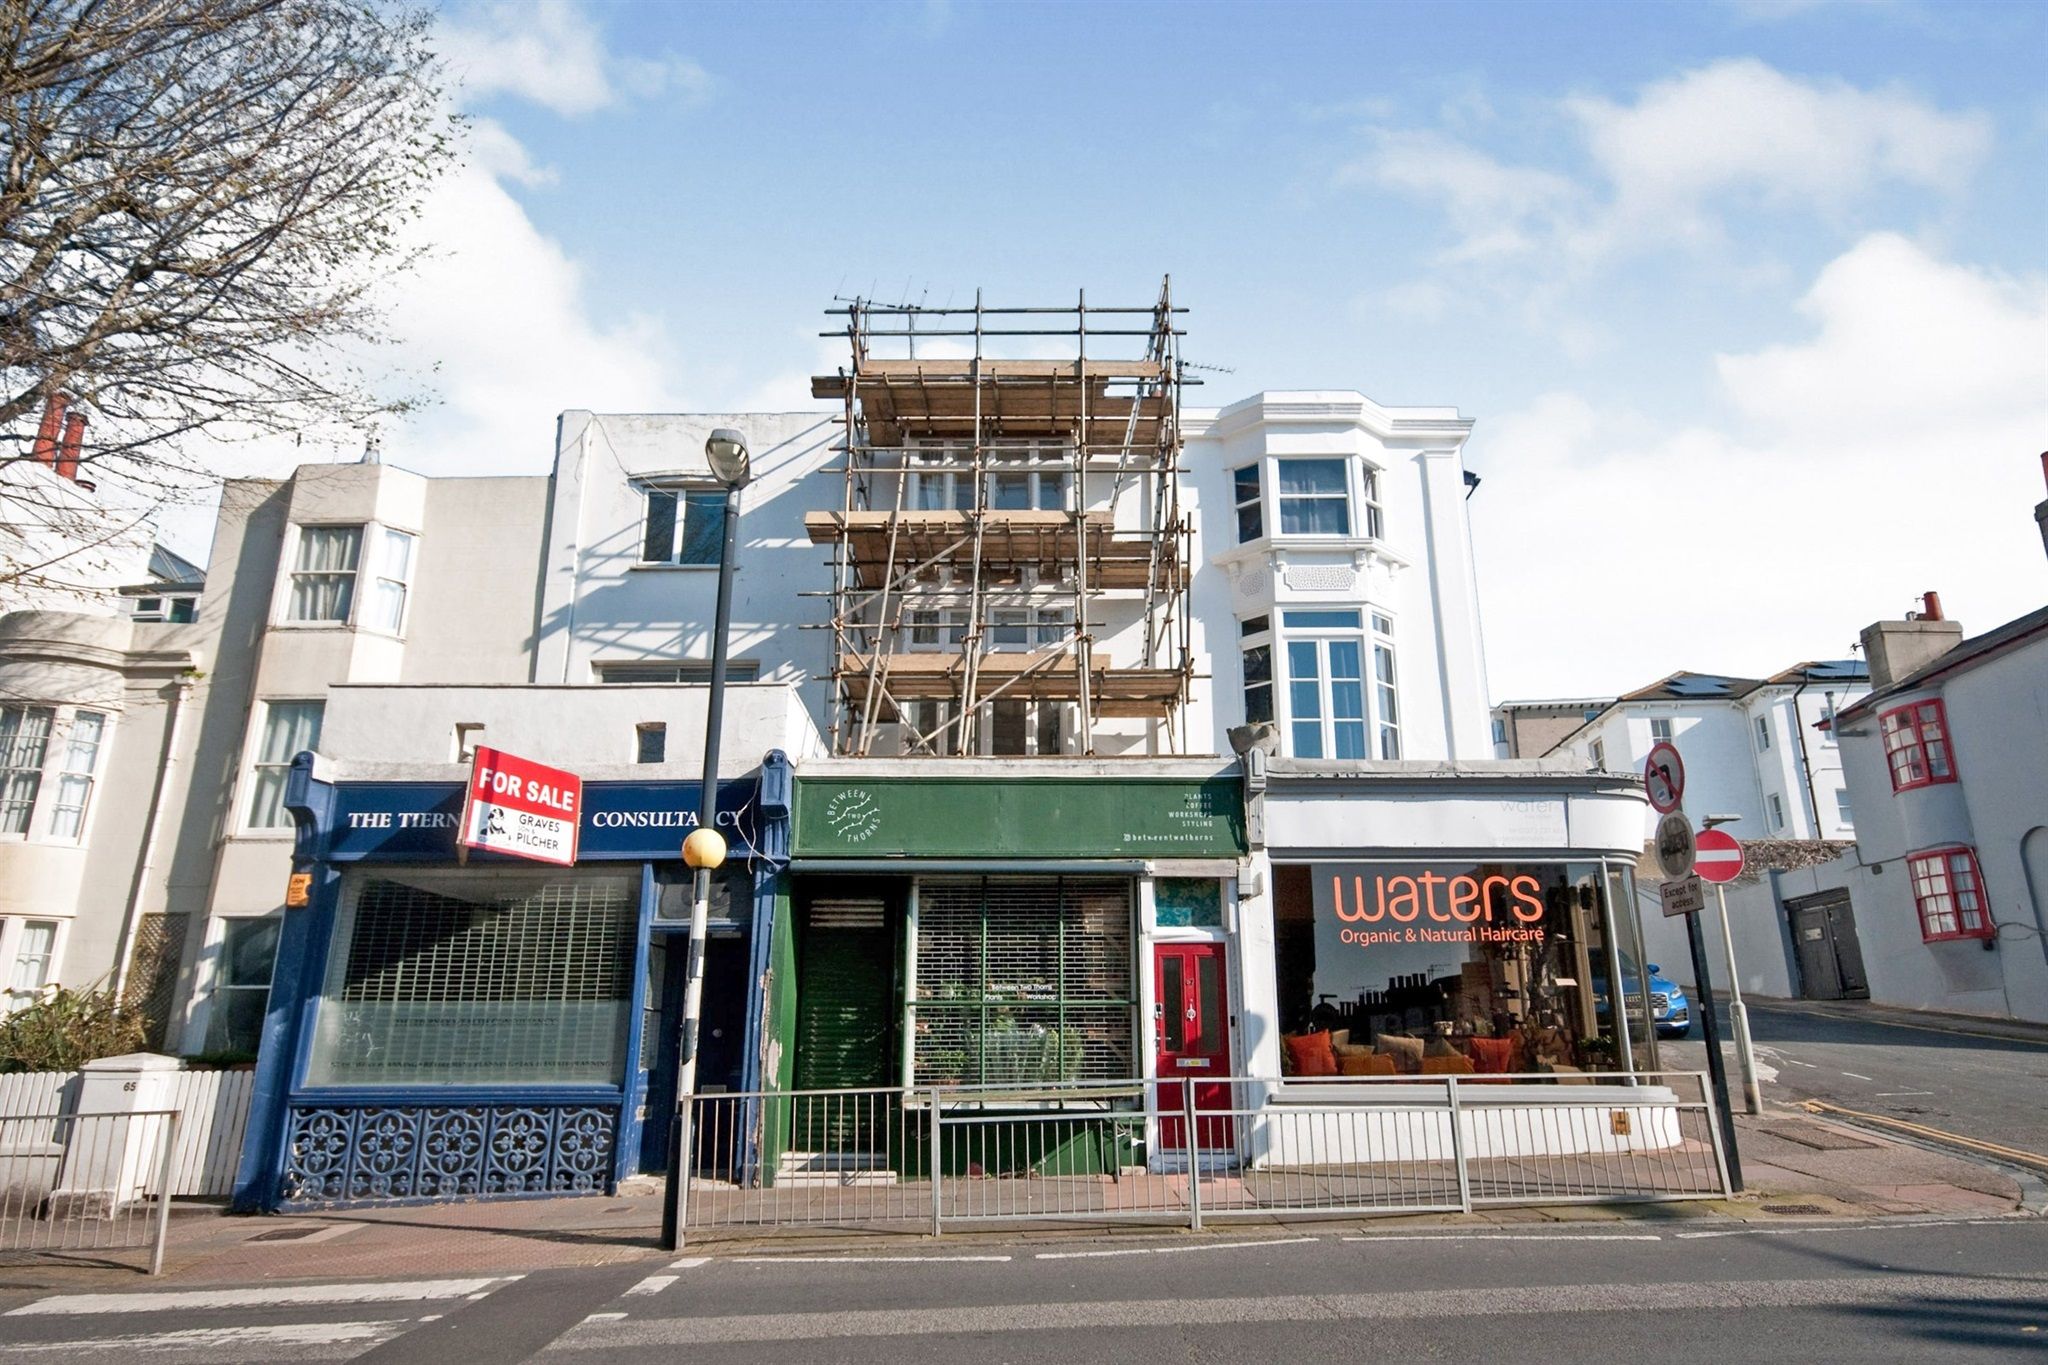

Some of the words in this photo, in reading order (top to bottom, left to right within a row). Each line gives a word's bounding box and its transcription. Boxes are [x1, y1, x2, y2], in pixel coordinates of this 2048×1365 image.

[479, 767, 522, 798] FOR
[526, 780, 574, 811] SALE
[827, 789, 866, 815] BETWEEN
[348, 812, 392, 828] THE
[398, 812, 460, 828] TIERN
[592, 810, 743, 827] CONSULTACY
[519, 814, 560, 833] GRAVES
[1182, 820, 1213, 828] STYLING
[847, 818, 881, 842] THORNS
[516, 832, 560, 850] PILCHER
[1333, 870, 1544, 922] waters
[1664, 885, 1687, 898] Except
[1688, 882, 1698, 892] for
[1672, 897, 1695, 909] access
[1340, 928, 1402, 947] Organic
[1405, 928, 1417, 942] &
[1420, 927, 1477, 942] Natural
[1480, 926, 1545, 942] Haircare
[123, 1081, 137, 1092] 65
